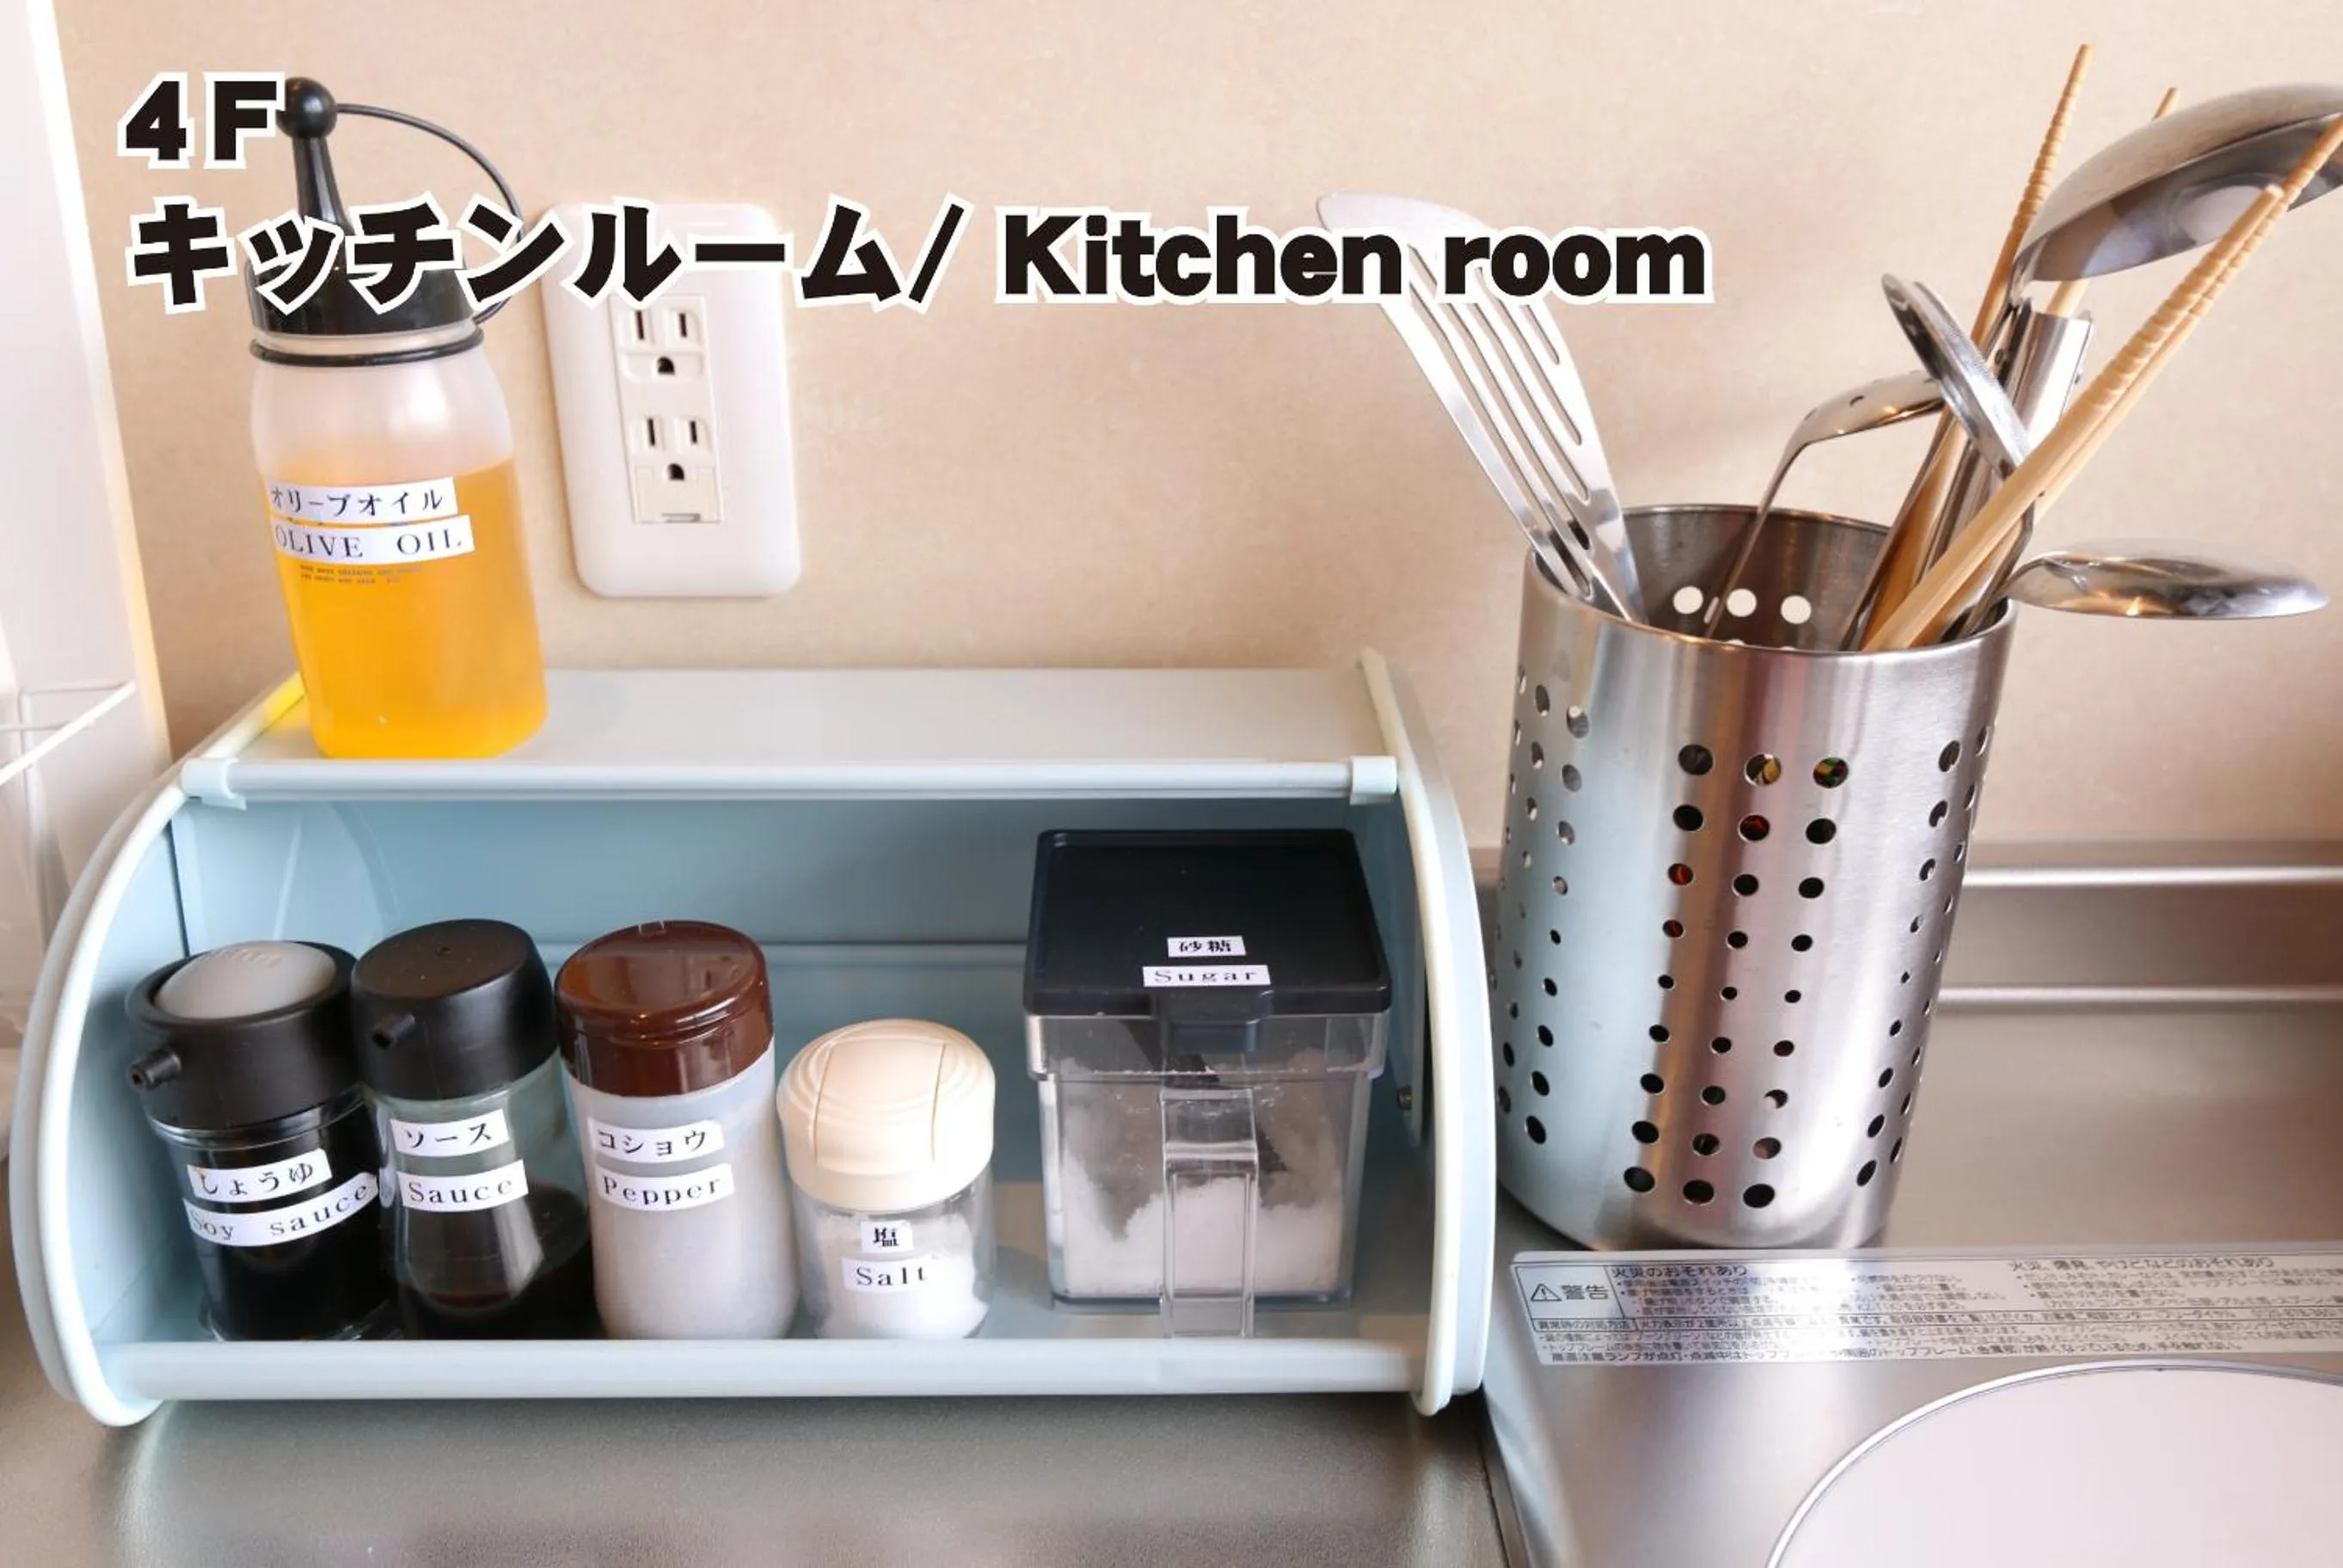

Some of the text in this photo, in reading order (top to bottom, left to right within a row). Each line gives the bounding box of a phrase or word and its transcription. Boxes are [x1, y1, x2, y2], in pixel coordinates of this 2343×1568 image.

[274, 523, 463, 559] OLIVE OIL
[1178, 939, 1233, 953] 砂糖
[1154, 970, 1257, 983] Sugar
[405, 1121, 494, 1149] ソース
[597, 1128, 708, 1157] コショウ
[198, 1161, 315, 1197] しょうゆ
[408, 1177, 513, 1204] Sauce
[603, 1175, 722, 1206] Pepper
[191, 1183, 369, 1241] Soy sauce
[872, 1227, 900, 1247] 塩
[856, 1265, 929, 1287] Salt
[1561, 1283, 1609, 1302] 警告
